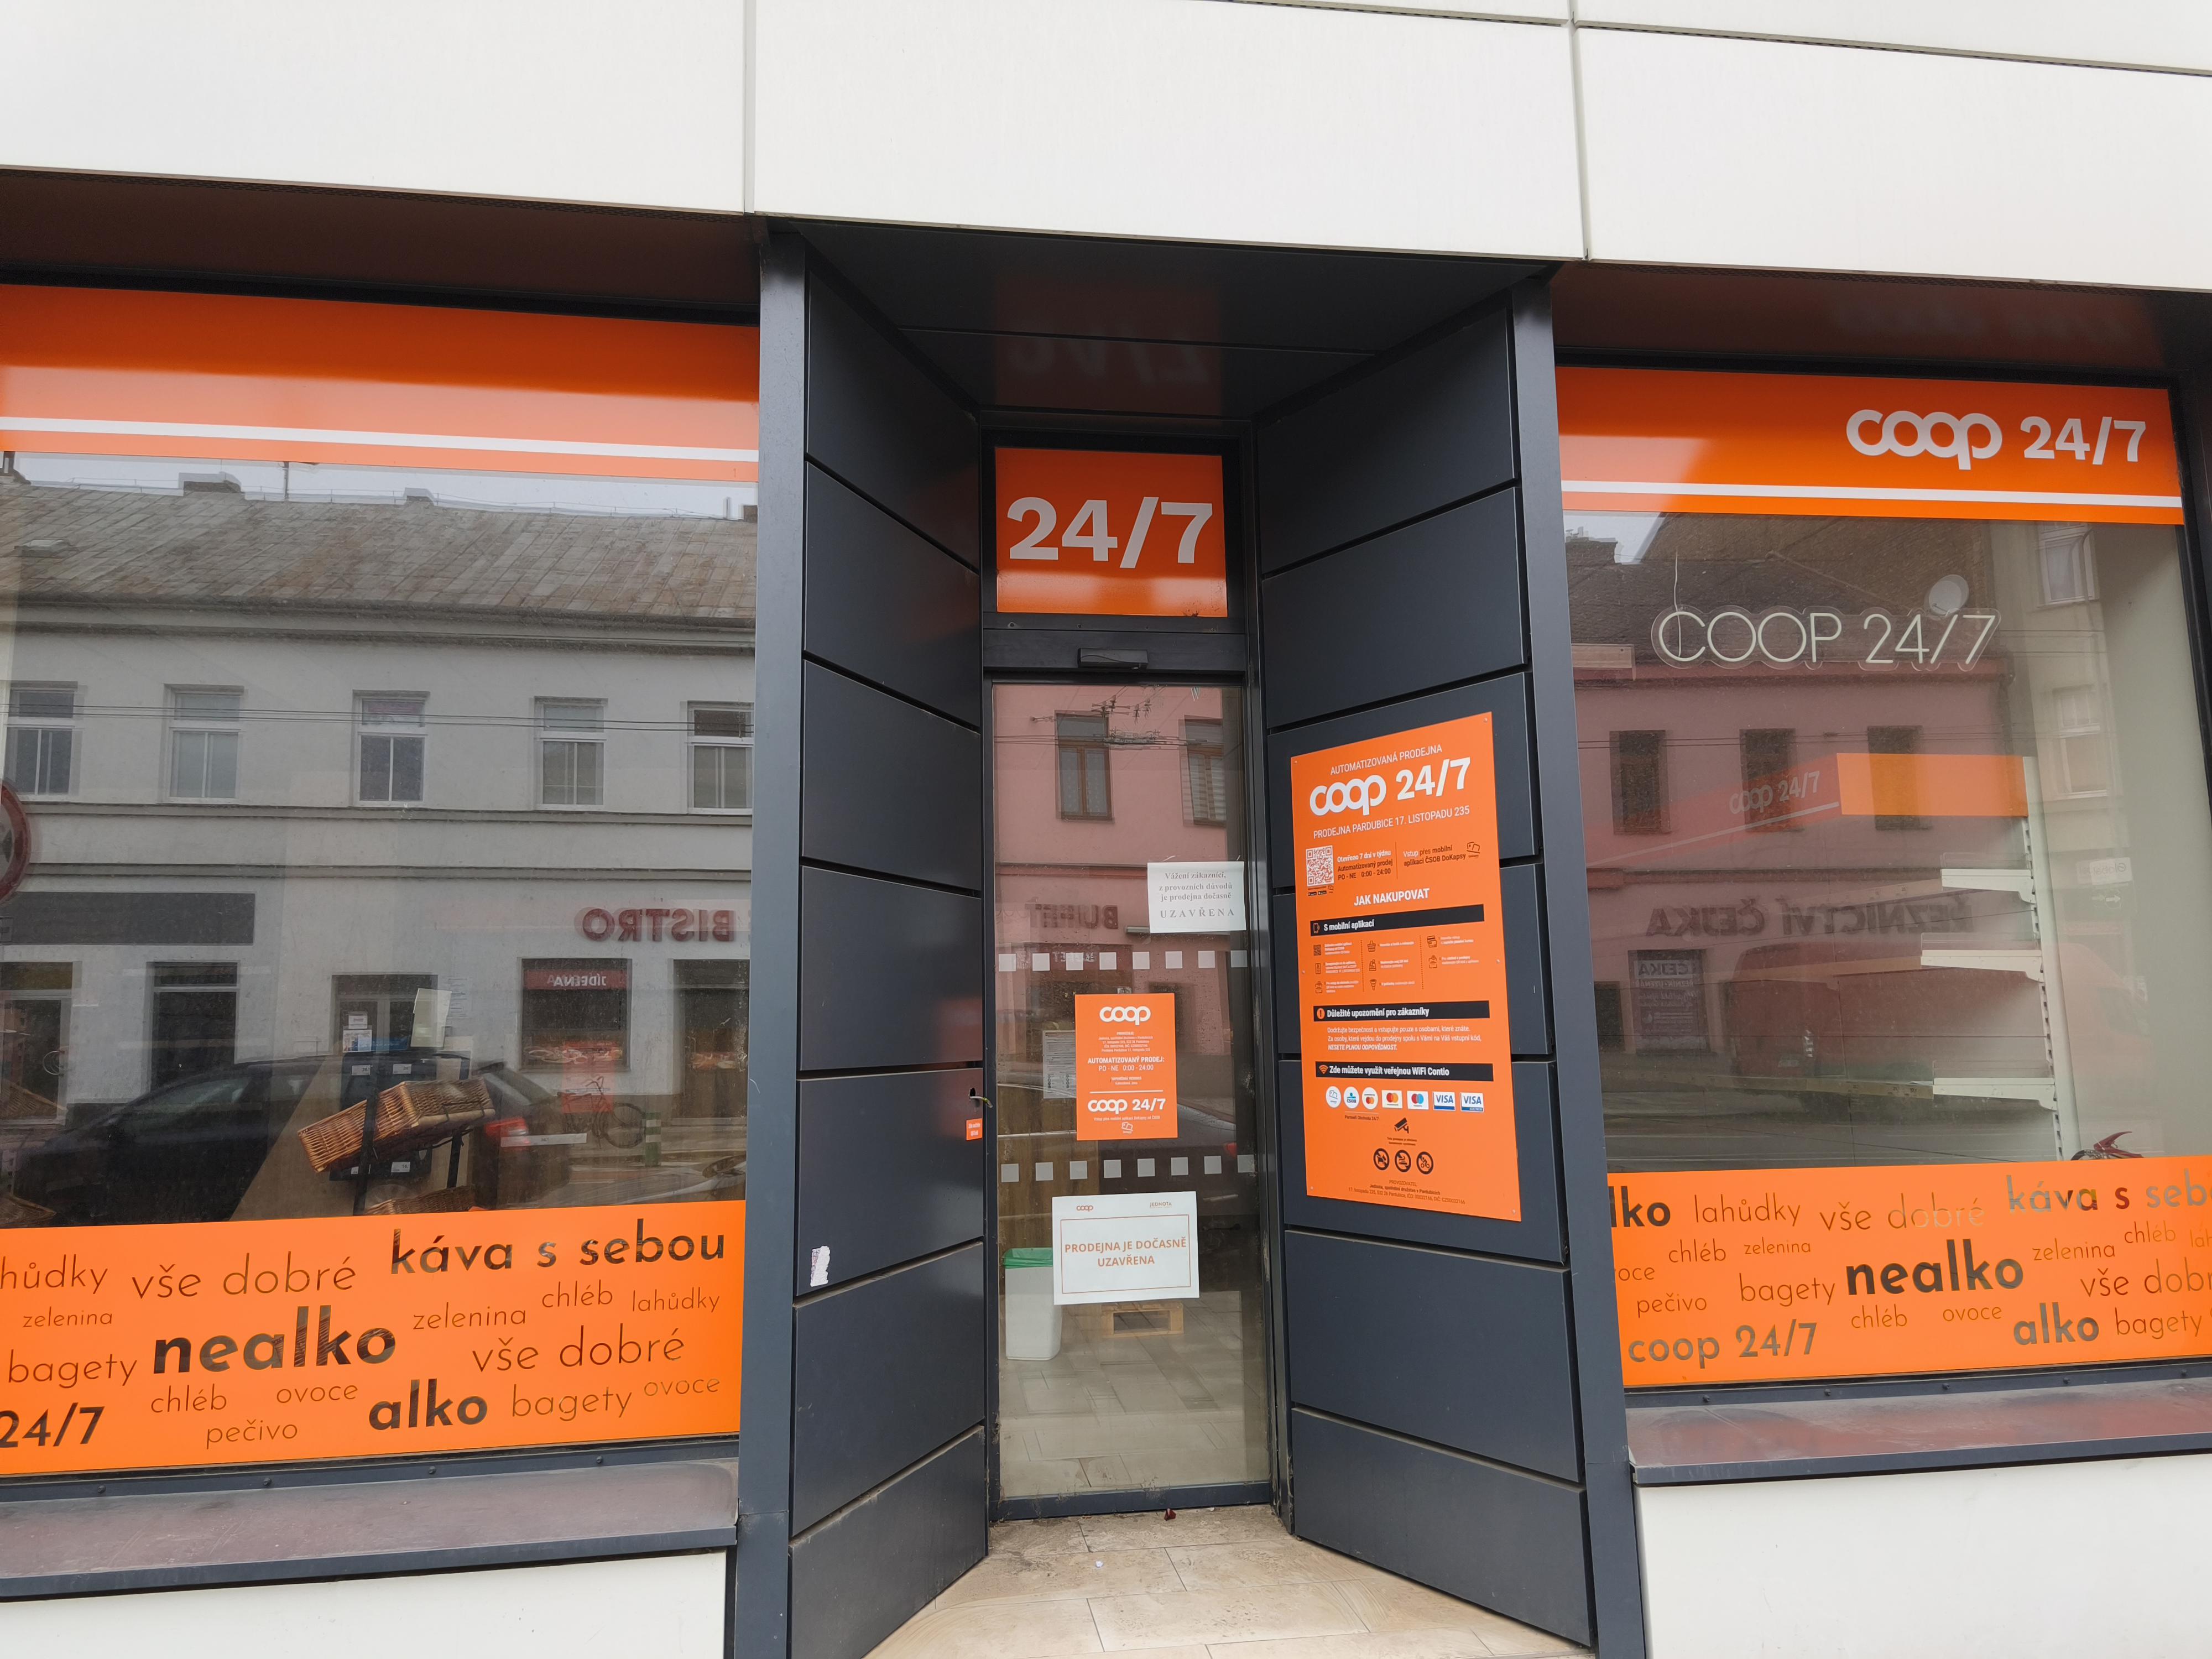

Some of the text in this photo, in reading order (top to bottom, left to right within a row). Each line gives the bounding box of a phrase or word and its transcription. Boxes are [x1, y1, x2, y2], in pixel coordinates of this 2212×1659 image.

[1846, 409, 2146, 470] coop 24/7
[1007, 496, 1213, 569] 24/7
[1658, 611, 1997, 665] COOP 24/7
[1330, 744, 1442, 775] AUTOMATIZOVANÁ PRODEJNA
[1310, 757, 1470, 816] coop 24/7
[1729, 770, 1820, 815] coop 24/7
[1313, 805, 1470, 839] PRODEJNA PARDUBICE 17. LISTOPADU 235
[1376, 850, 1391, 858] týdnu
[1425, 855, 1441, 864] ČSOB
[1432, 845, 1453, 853] mobilní
[1337, 859, 1393, 872] Automatizovaný prodej
[1165, 884, 1204, 893] provozních
[1170, 893, 1202, 902] prodejna
[1204, 891, 1232, 900] dočasně
[1354, 888, 1430, 906] JAK NAKUPOVAT
[1329, 920, 1350, 931] mobilní
[1099, 1006, 1151, 1025] coop
[1327, 1007, 1430, 1018] Důležité upozornění pro zákazníky
[1088, 1056, 1139, 1064] AUTOMATIZOVANÝ
[1342, 1065, 1363, 1074] můžete
[1364, 1066, 1383, 1076] využít
[1384, 1066, 1411, 1077] veřejnou
[1411, 1067, 1426, 1075] WiFi
[1428, 1067, 1449, 1076] Contio
[1088, 1098, 1166, 1114] coop 24/7
[1436, 1094, 1454, 1104] VISA
[1463, 1095, 1482, 1105] VISA
[1694, 1192, 1800, 1227] lahůdky
[1820, 1201, 1871, 1232] vše
[1888, 1192, 1985, 1230] dobré
[2006, 1174, 2098, 1215] káva
[2115, 1187, 2130, 1209] s
[2146, 1167, 2212, 1208] seb
[1065, 1237, 1186, 1254] PRODEJNA JE DOČASNĚ
[2124, 1220, 2176, 1244] chléb
[391, 1218, 724, 1275] káva s sebou
[1668, 1237, 1811, 1263] chléb zelenina
[1098, 1254, 1155, 1267] UZAVŘENA
[1615, 1266, 1655, 1281] oce
[1846, 1238, 2115, 1296] nealko zelenina
[0, 1250, 356, 1299] hůdky vše dobré
[2080, 1268, 2128, 1297] vše
[541, 1279, 720, 1313] chléb lahůdky
[1739, 1272, 1835, 1307] bagety
[1637, 1292, 1707, 1318] pečivo
[1851, 1302, 2202, 1345] chléb ovoce alko bagety
[23, 1302, 526, 1374] zelenina nealko zelenina
[472, 1322, 685, 1373] vše dobré
[1628, 1319, 1817, 1369] coop 24/7
[8, 1349, 358, 1413] bagety chléb ovoce
[368, 1378, 721, 1431] alko bagety ovoce
[0, 1401, 298, 1449] 24/7 pečivo
